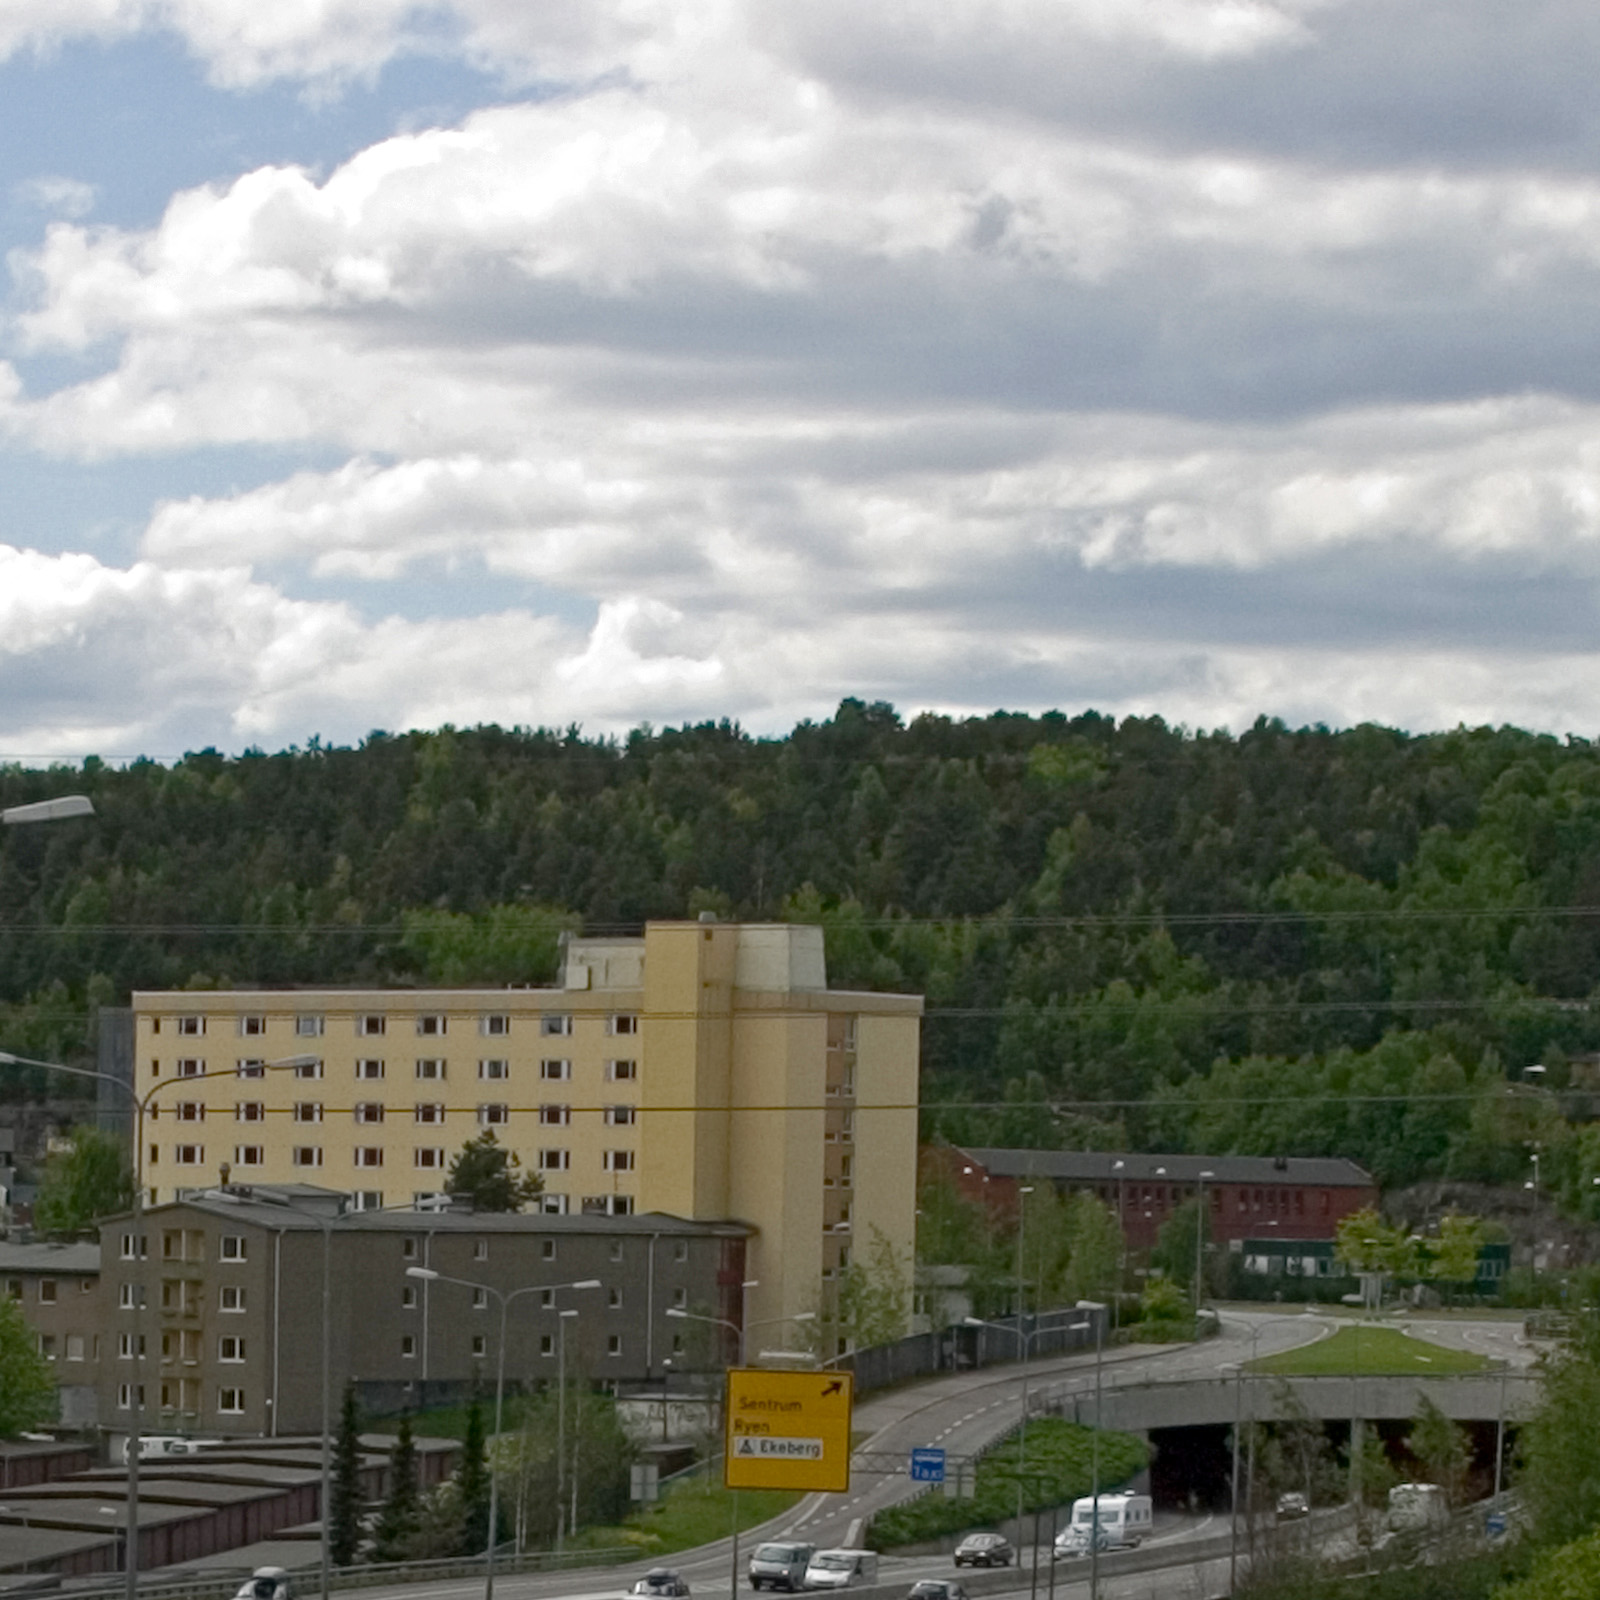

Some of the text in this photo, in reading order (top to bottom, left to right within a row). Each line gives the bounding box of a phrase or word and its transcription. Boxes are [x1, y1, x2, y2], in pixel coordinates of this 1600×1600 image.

[739, 1396, 803, 1412] Sentrum
[733, 1418, 770, 1435] Ryen
[759, 1439, 820, 1458] Ekeberg
[913, 1465, 943, 1480] Taxi
